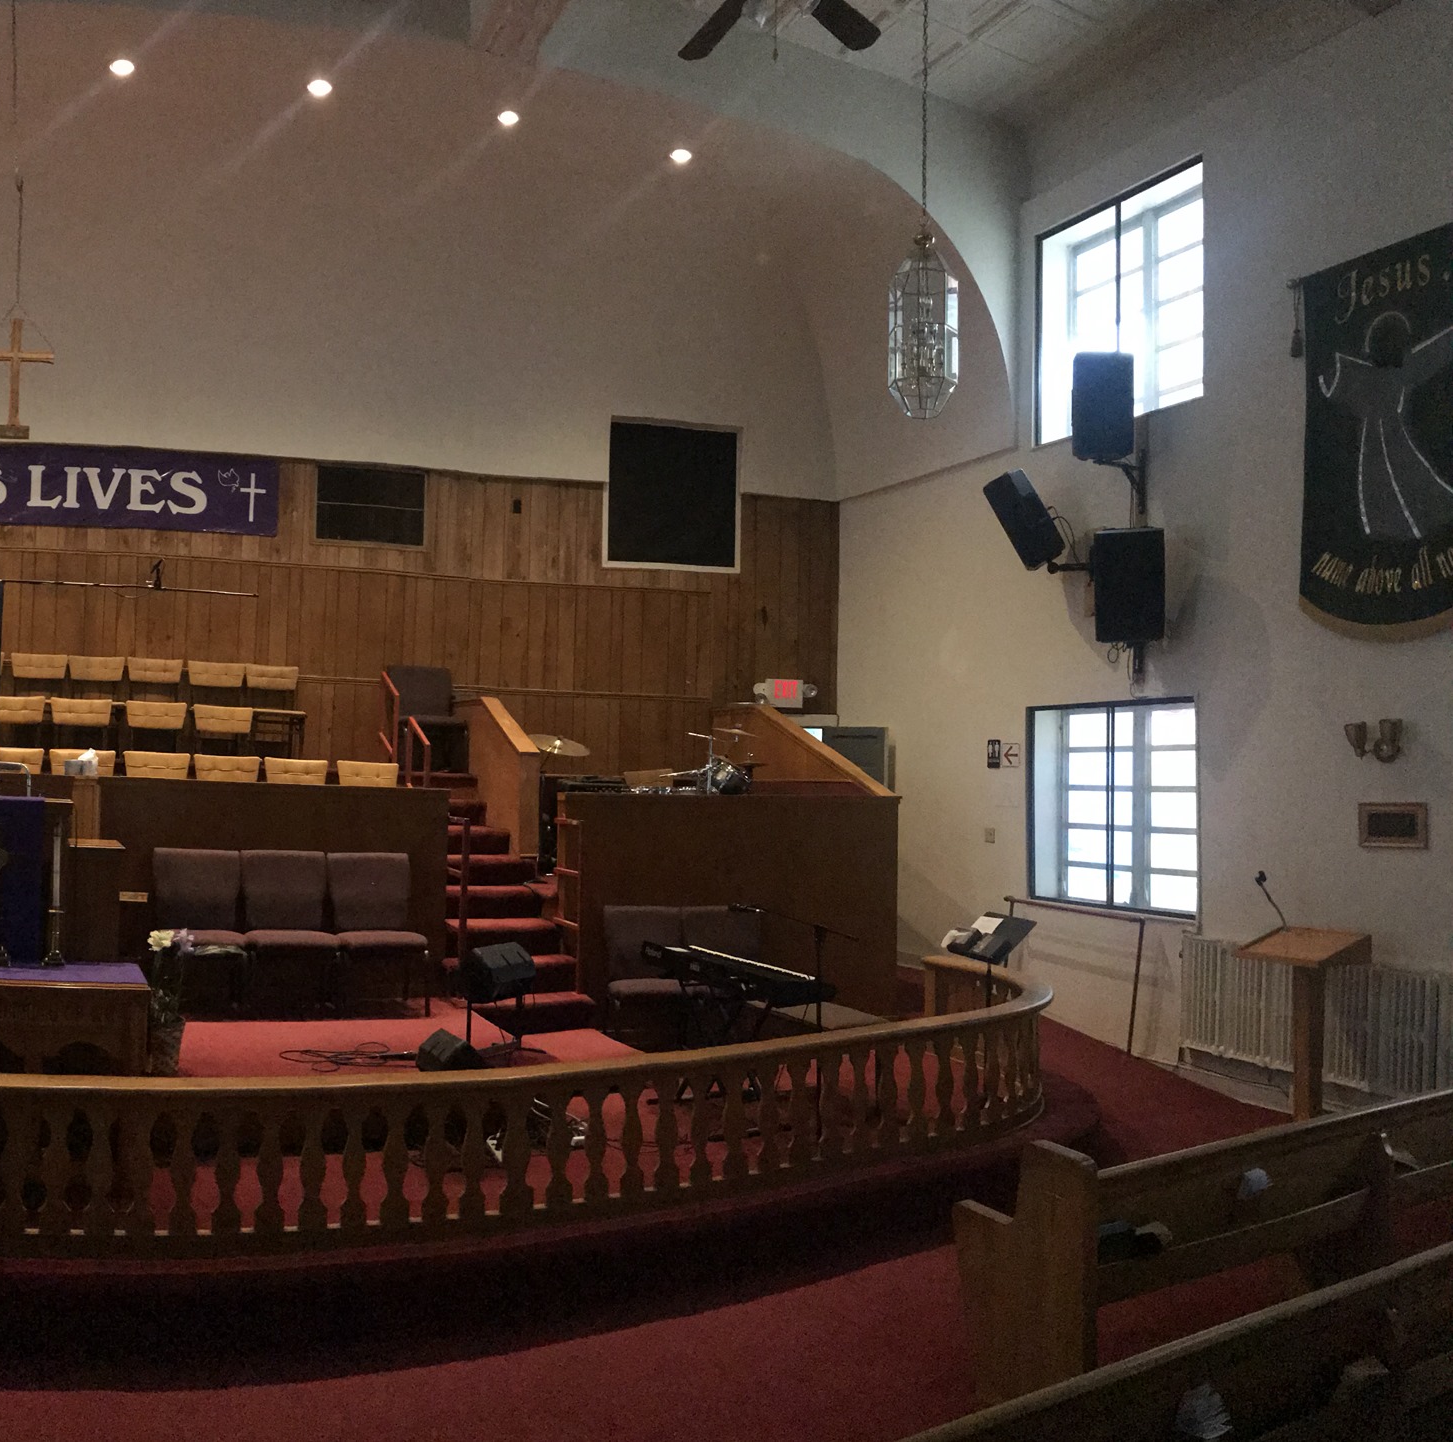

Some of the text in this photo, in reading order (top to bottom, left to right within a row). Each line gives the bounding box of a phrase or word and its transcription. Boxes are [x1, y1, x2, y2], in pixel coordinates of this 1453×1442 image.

[1334, 254, 1431, 323] Jesus
[26, 464, 207, 515] LIVES
[1355, 555, 1402, 595] above
[1411, 545, 1433, 590] all
[774, 680, 798, 699] EXIT
